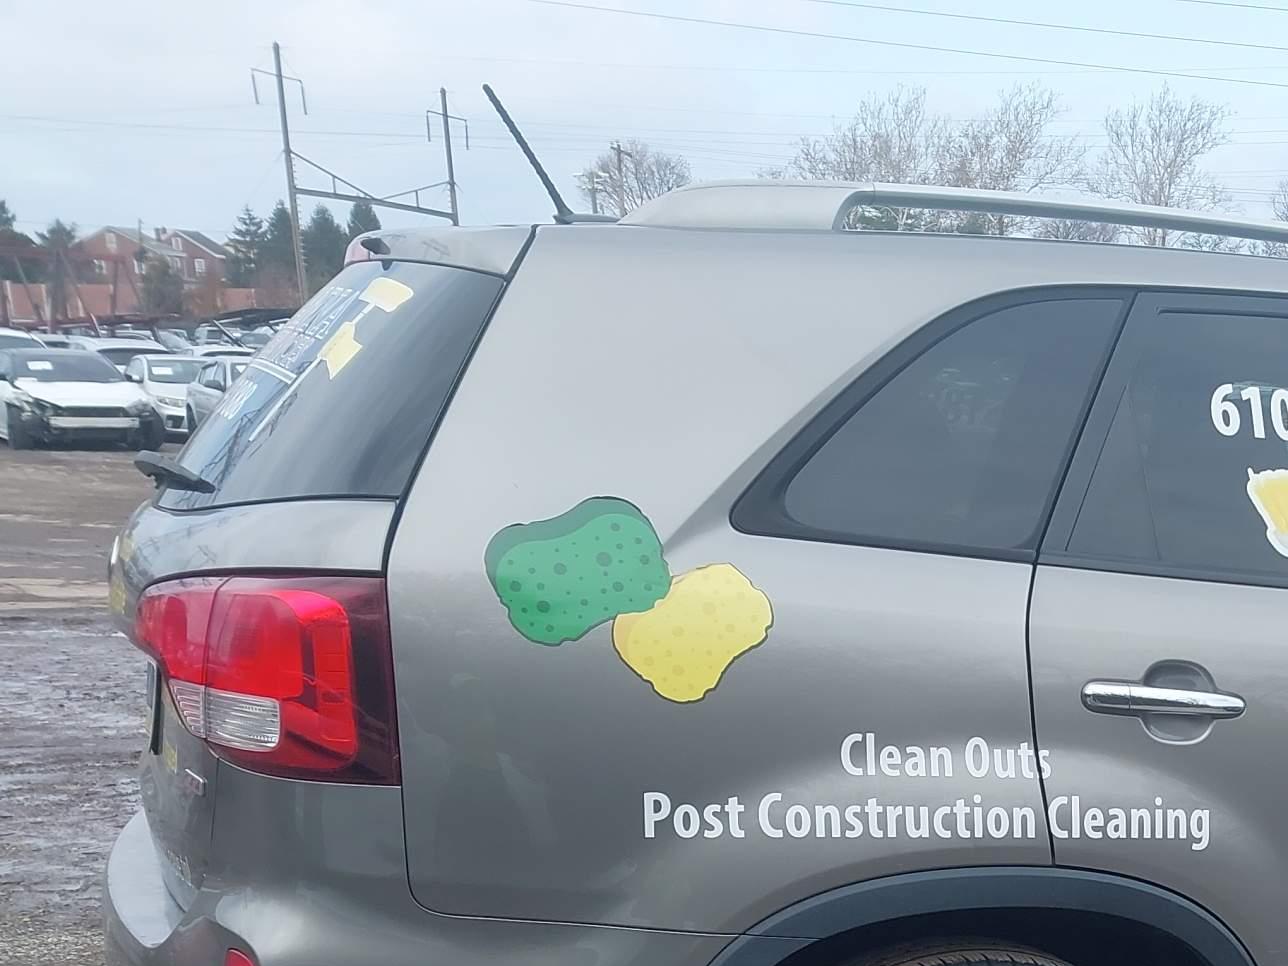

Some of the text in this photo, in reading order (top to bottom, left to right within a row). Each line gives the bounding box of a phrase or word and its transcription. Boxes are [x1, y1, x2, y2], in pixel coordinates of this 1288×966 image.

[839, 733, 1052, 780] Clean Outs
[642, 792, 1210, 851] Post Construction Cleaning
